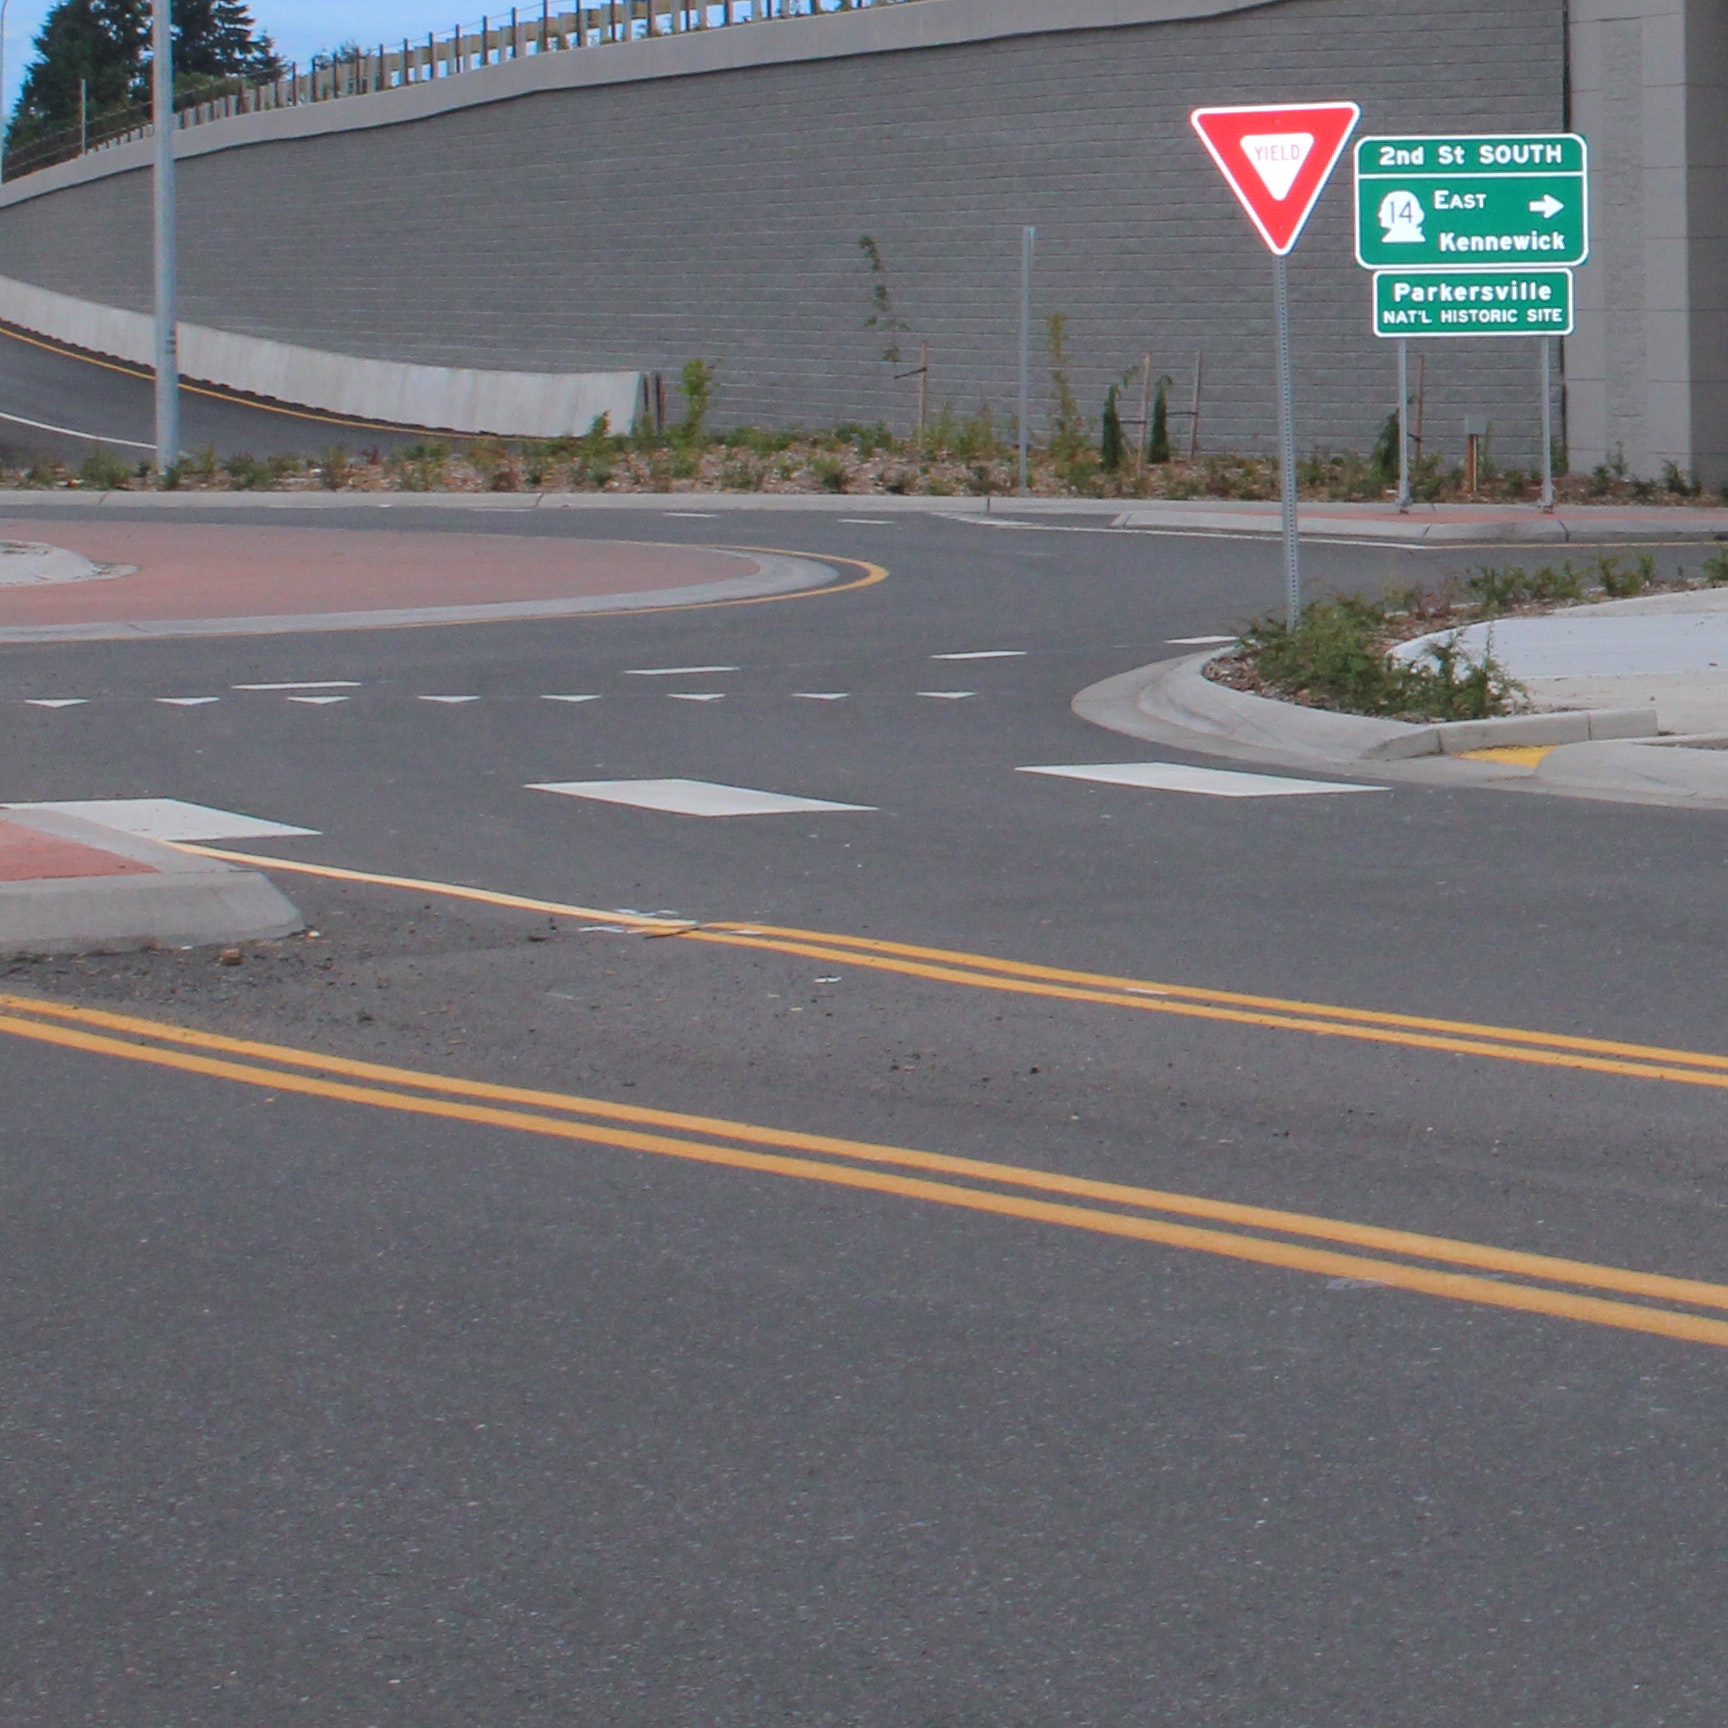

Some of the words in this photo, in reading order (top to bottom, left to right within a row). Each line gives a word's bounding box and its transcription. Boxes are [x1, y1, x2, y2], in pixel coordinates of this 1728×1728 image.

[1254, 144, 1300, 161] YIELD
[1379, 146, 1424, 166] 2nd
[1438, 145, 1465, 165] St
[1479, 144, 1562, 164] SOUTH
[1434, 189, 1487, 209] EAST
[1390, 200, 1413, 224] 14
[1439, 230, 1565, 252] Kennewick
[1394, 280, 1552, 302] Parkersville
[1383, 309, 1432, 324] NAT'L
[1440, 308, 1518, 323] HISTORIC
[1526, 308, 1563, 322] SITE
